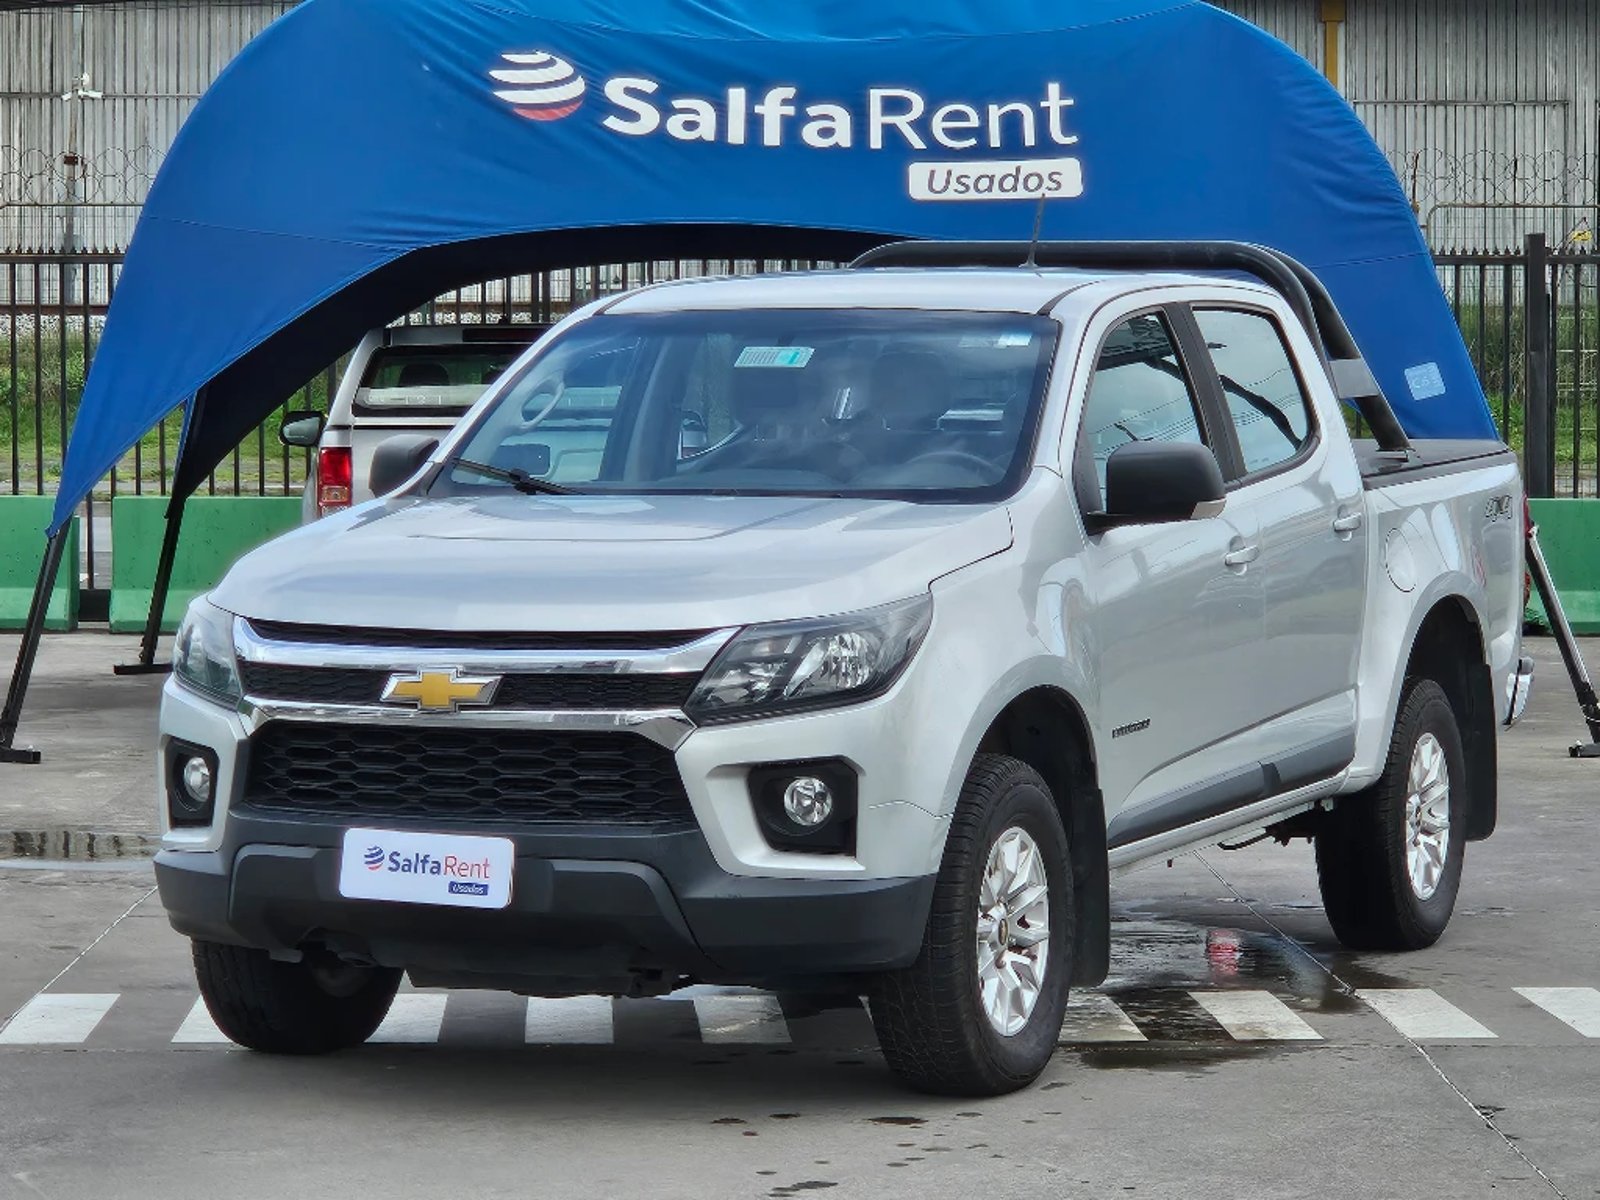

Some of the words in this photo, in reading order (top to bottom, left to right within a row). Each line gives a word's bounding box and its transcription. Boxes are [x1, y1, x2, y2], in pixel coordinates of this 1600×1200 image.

[603, 77, 1078, 149] SalfaRent
[926, 164, 1064, 195] Usados
[452, 883, 484, 895] Usados
